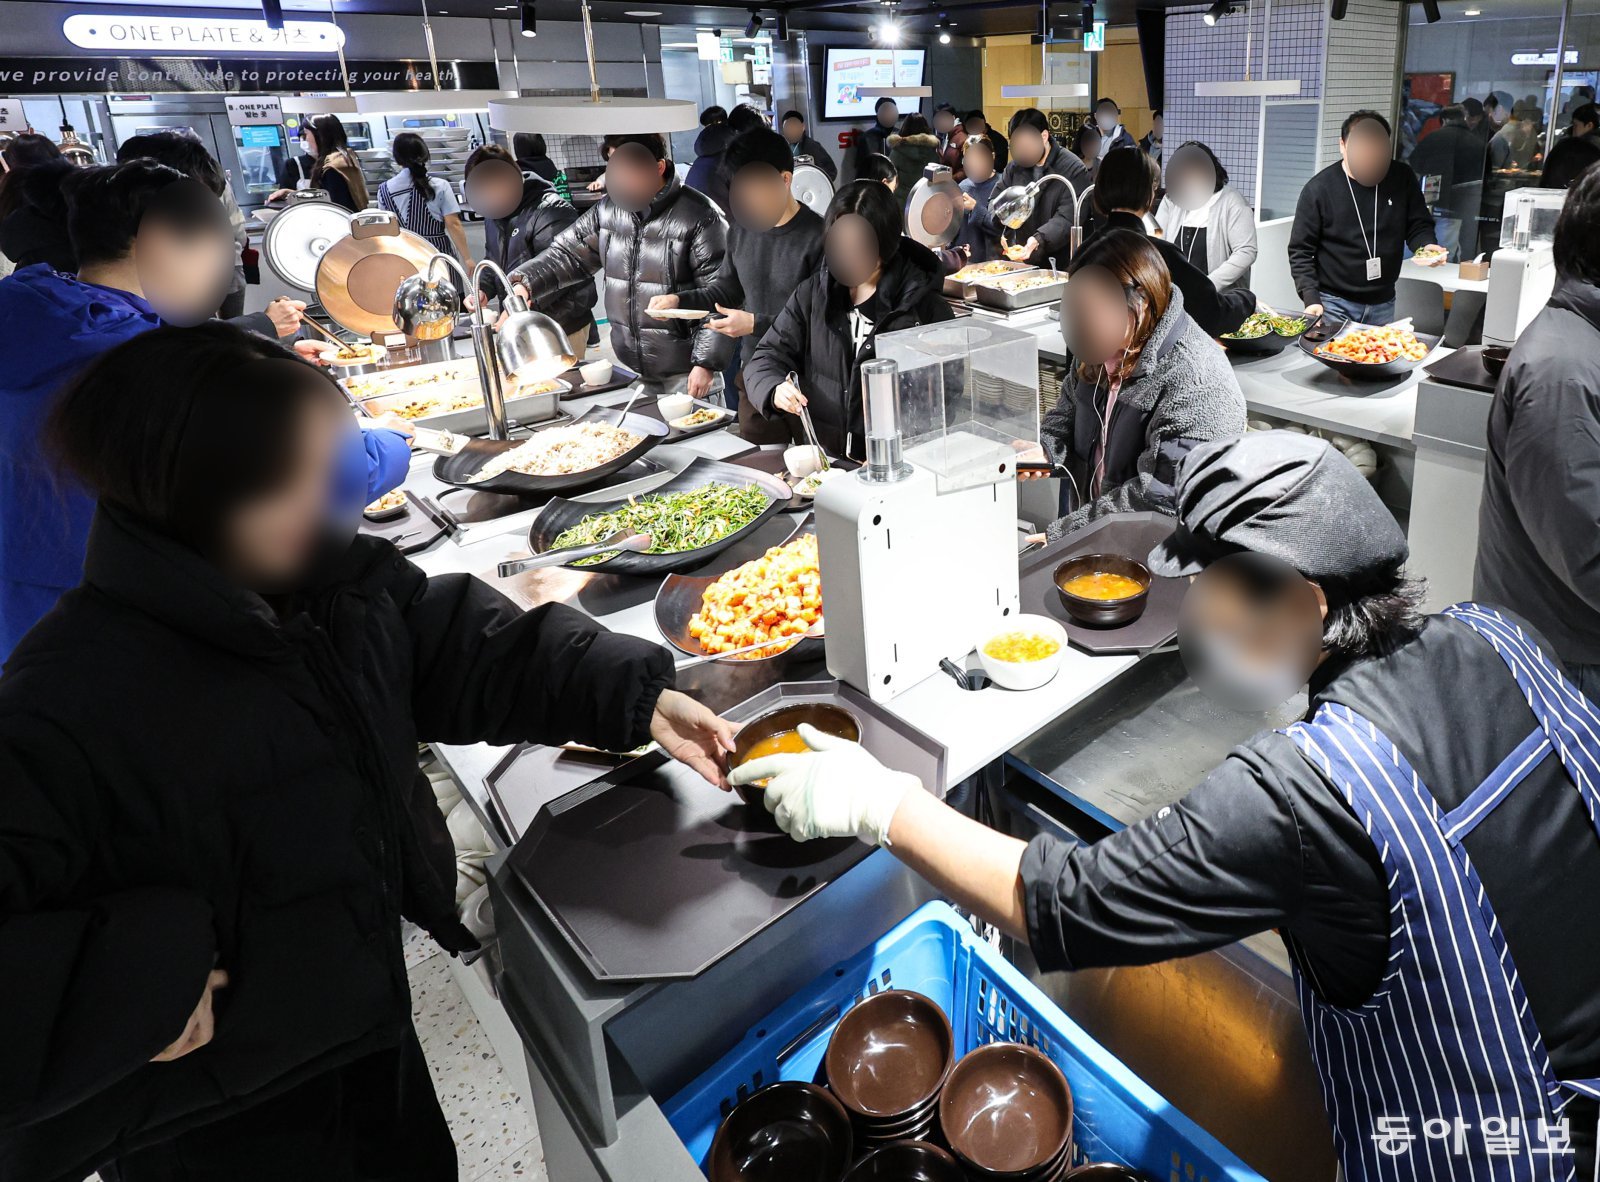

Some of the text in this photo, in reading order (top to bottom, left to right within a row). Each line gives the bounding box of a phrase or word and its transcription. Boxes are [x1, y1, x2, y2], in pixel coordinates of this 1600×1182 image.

[109, 24, 164, 41] ONE
[170, 26, 243, 43] PLATE
[249, 27, 265, 43] &
[32, 67, 120, 85] provide
[241, 69, 259, 82] to
[265, 68, 359, 85] protecting
[362, 70, 401, 84] your
[256, 103, 280, 111] PLATE
